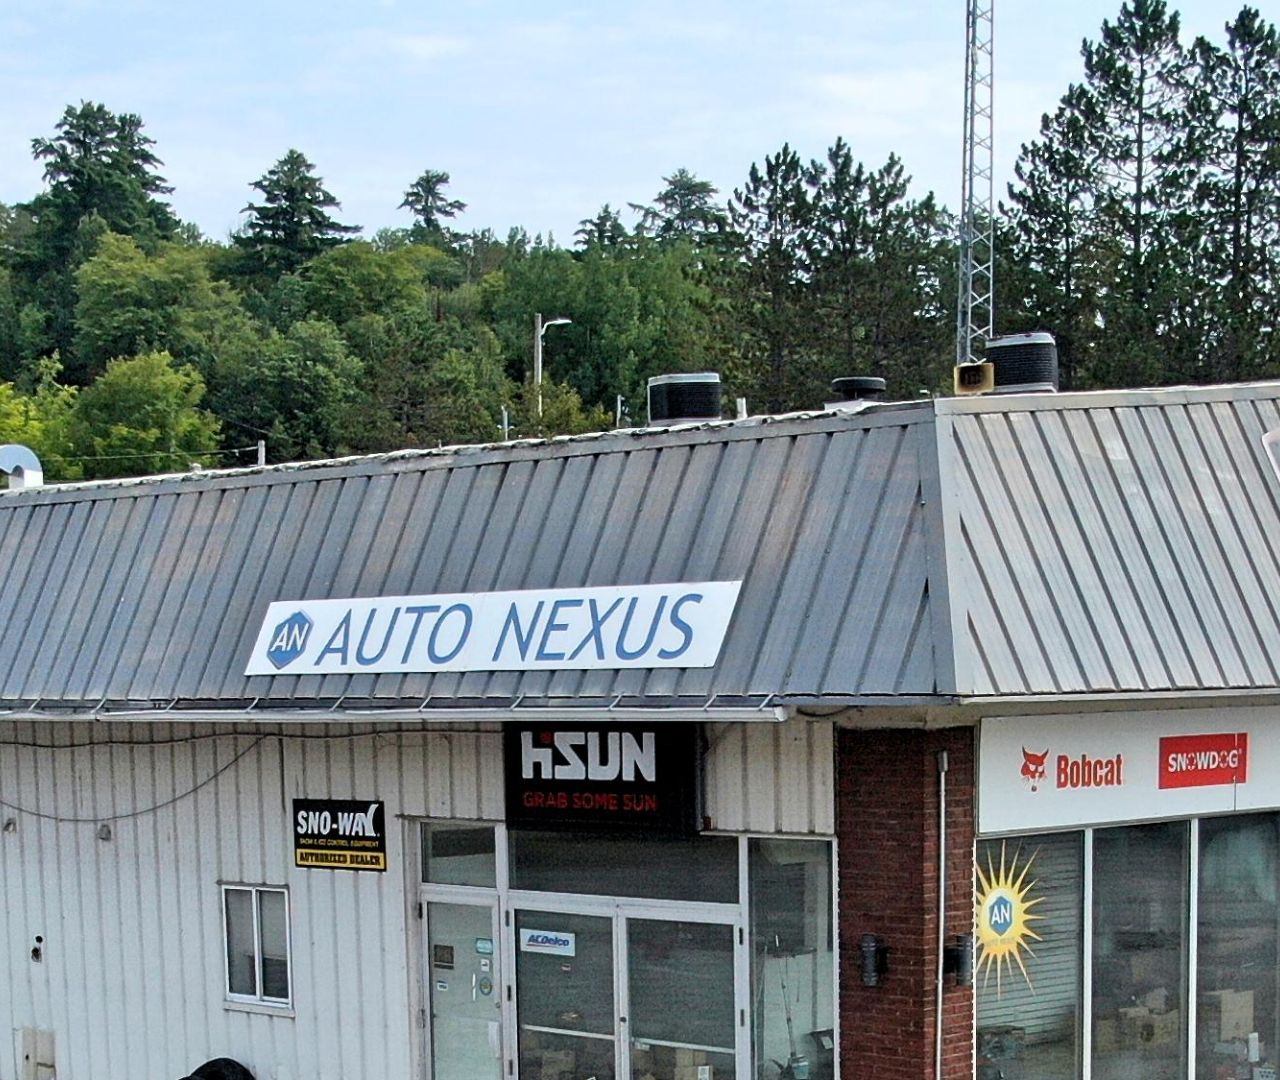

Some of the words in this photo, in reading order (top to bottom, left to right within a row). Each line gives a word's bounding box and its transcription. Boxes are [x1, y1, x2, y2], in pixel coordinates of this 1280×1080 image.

[270, 623, 309, 652] AN
[315, 603, 473, 666] AUTO
[492, 593, 702, 662] NEXUS
[1057, 754, 1122, 788] Bobcat
[1168, 749, 1238, 773] SNOWDOG
[523, 791, 569, 809] GRAB
[572, 792, 619, 810] SOME
[623, 794, 657, 811] SUN
[297, 804, 379, 837] SNO-WAY
[349, 854, 380, 865] DEALER
[991, 903, 1011, 925] AN
[527, 934, 570, 947] ACDelco
